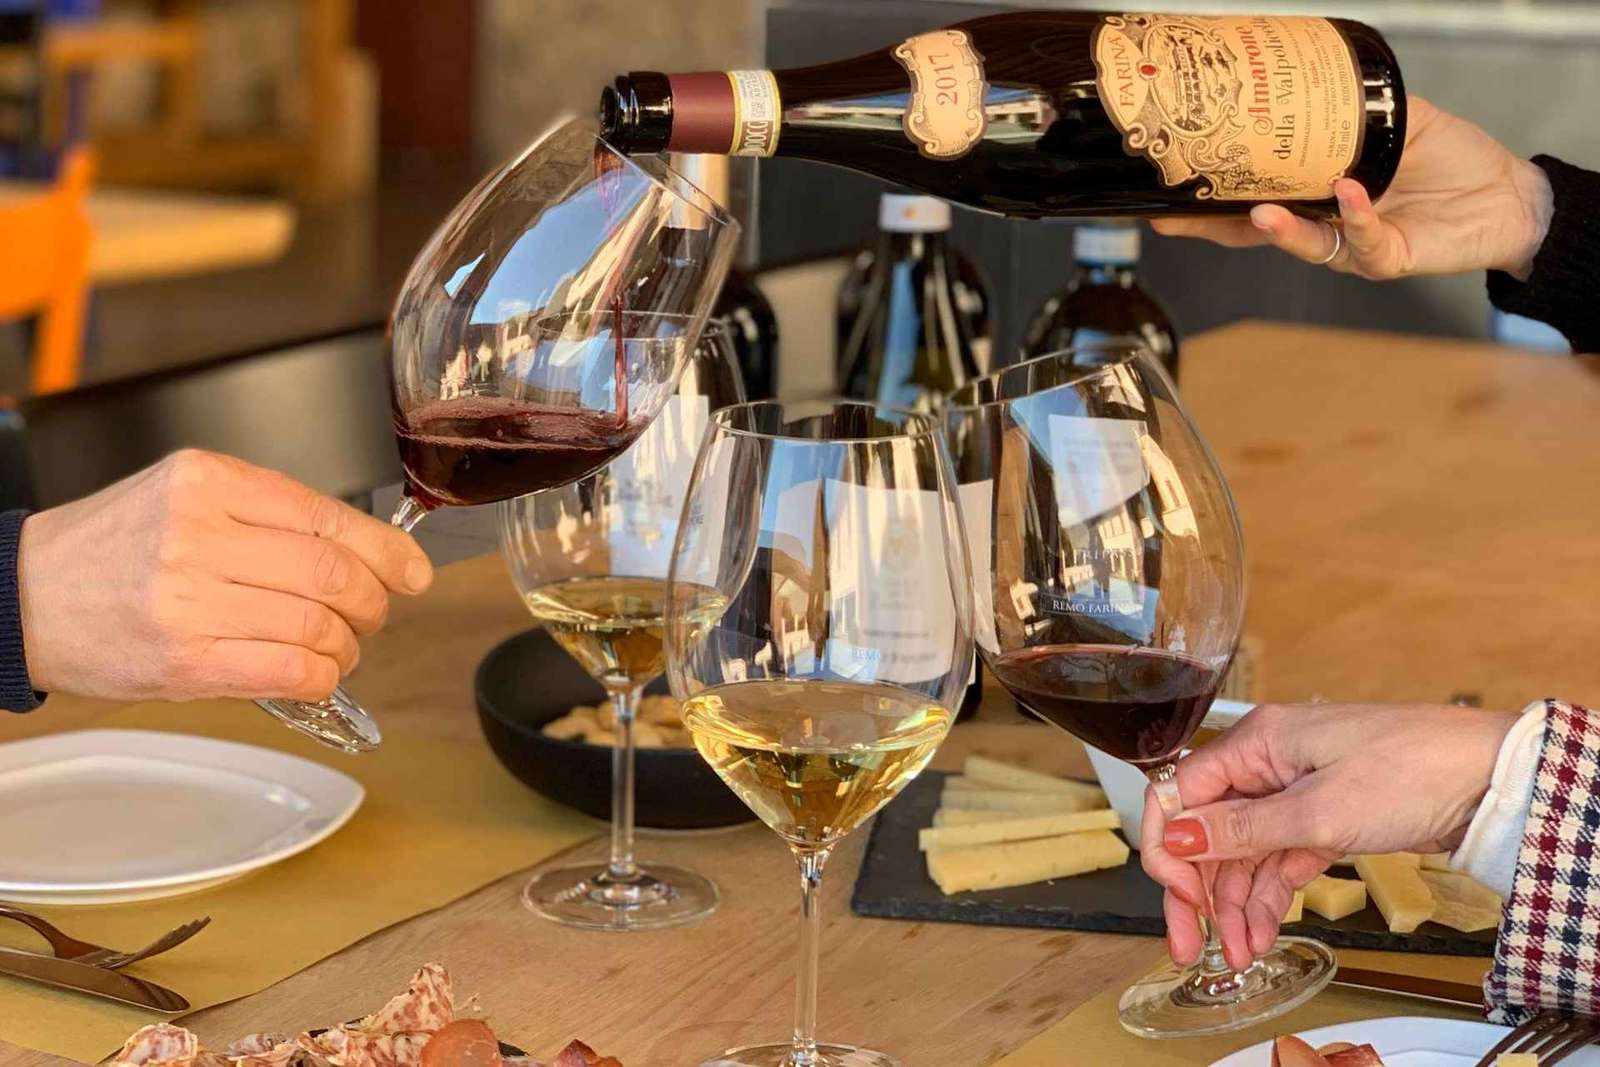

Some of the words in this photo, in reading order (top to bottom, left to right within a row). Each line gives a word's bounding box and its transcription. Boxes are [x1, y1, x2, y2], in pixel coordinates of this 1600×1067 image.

[929, 52, 958, 106] 2017
[1107, 35, 1136, 107] FARINA
[1235, 25, 1273, 136] Amarone
[1273, 114, 1295, 160] della
[1052, 599, 1085, 613] REMO
